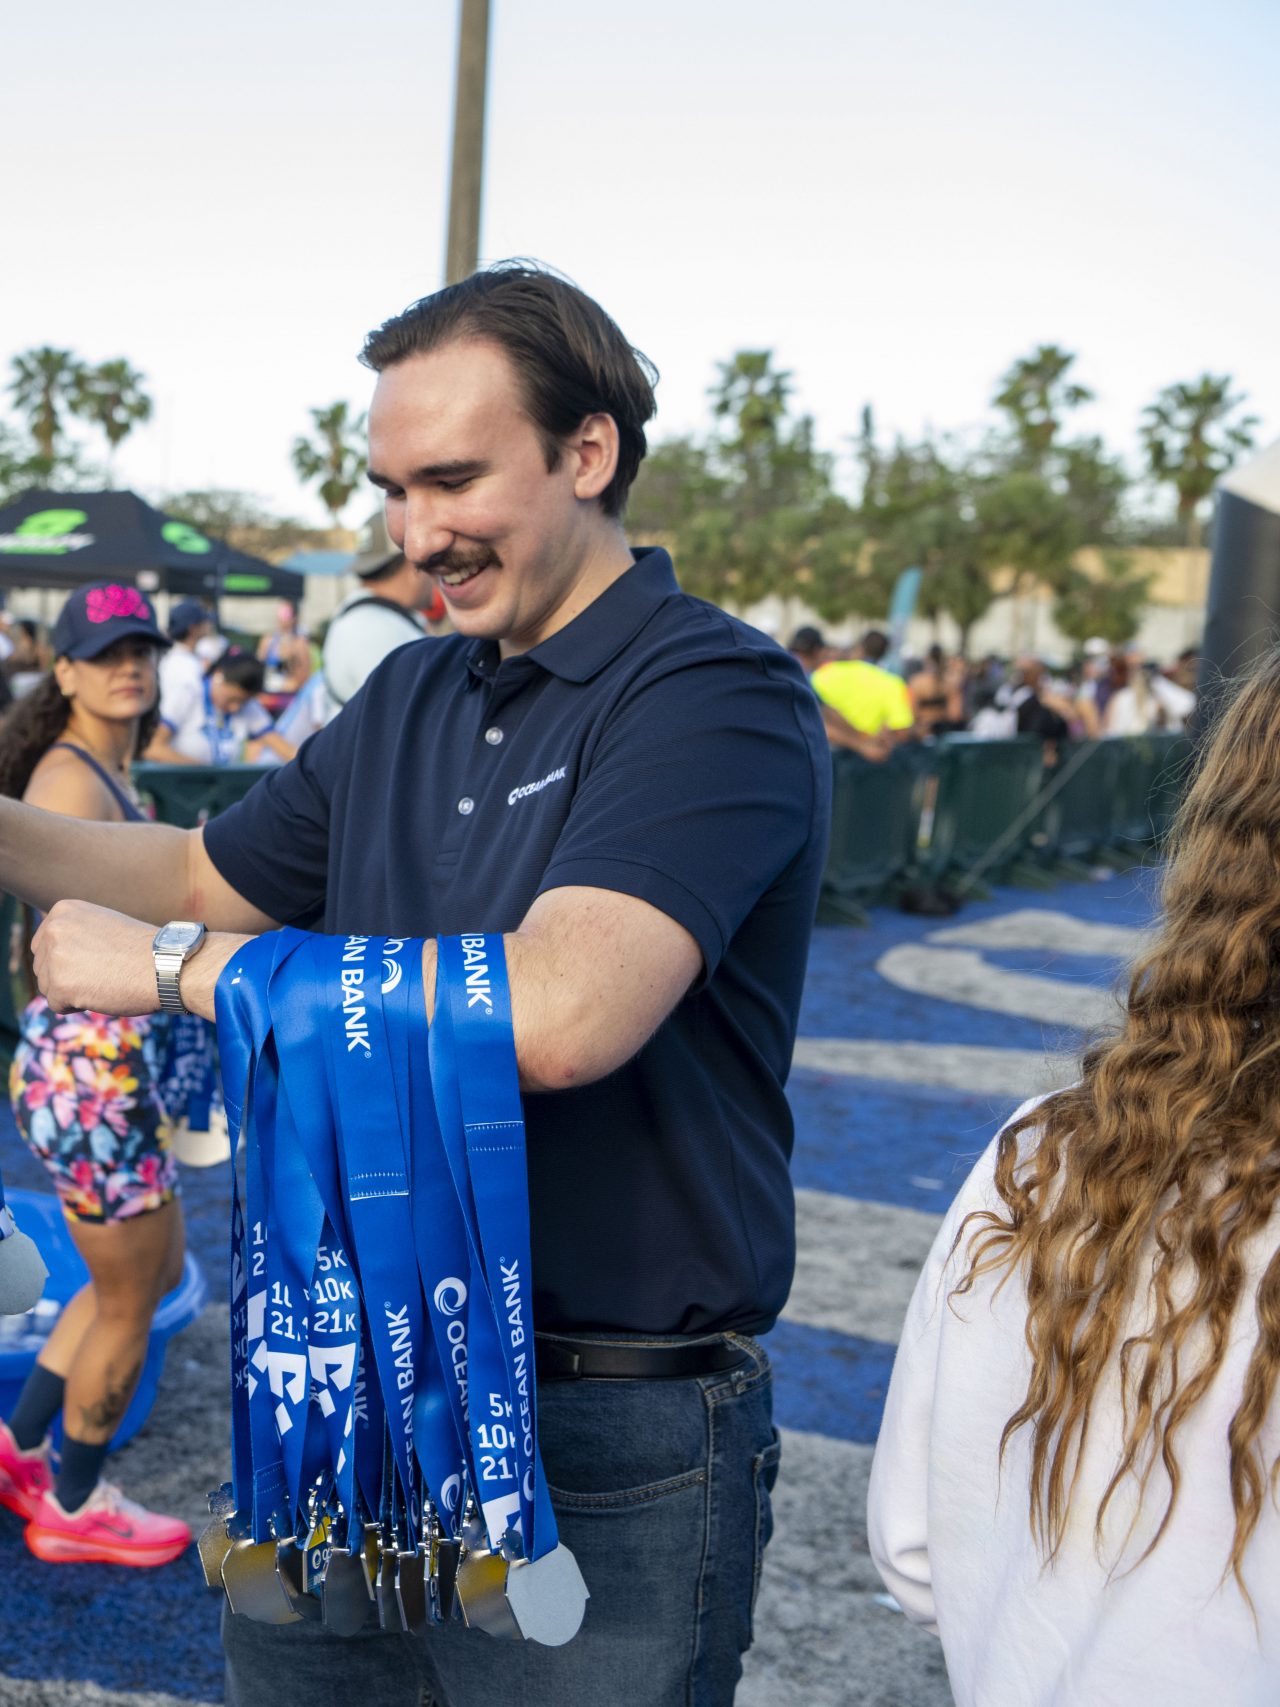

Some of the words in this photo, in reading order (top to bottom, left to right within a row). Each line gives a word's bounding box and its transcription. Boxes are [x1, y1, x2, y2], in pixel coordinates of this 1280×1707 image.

[314, 1278, 354, 1304] 10K
[313, 1308, 356, 1333] 21K
[514, 1352, 534, 1457] OCEAN
[480, 1455, 519, 1480] 21
